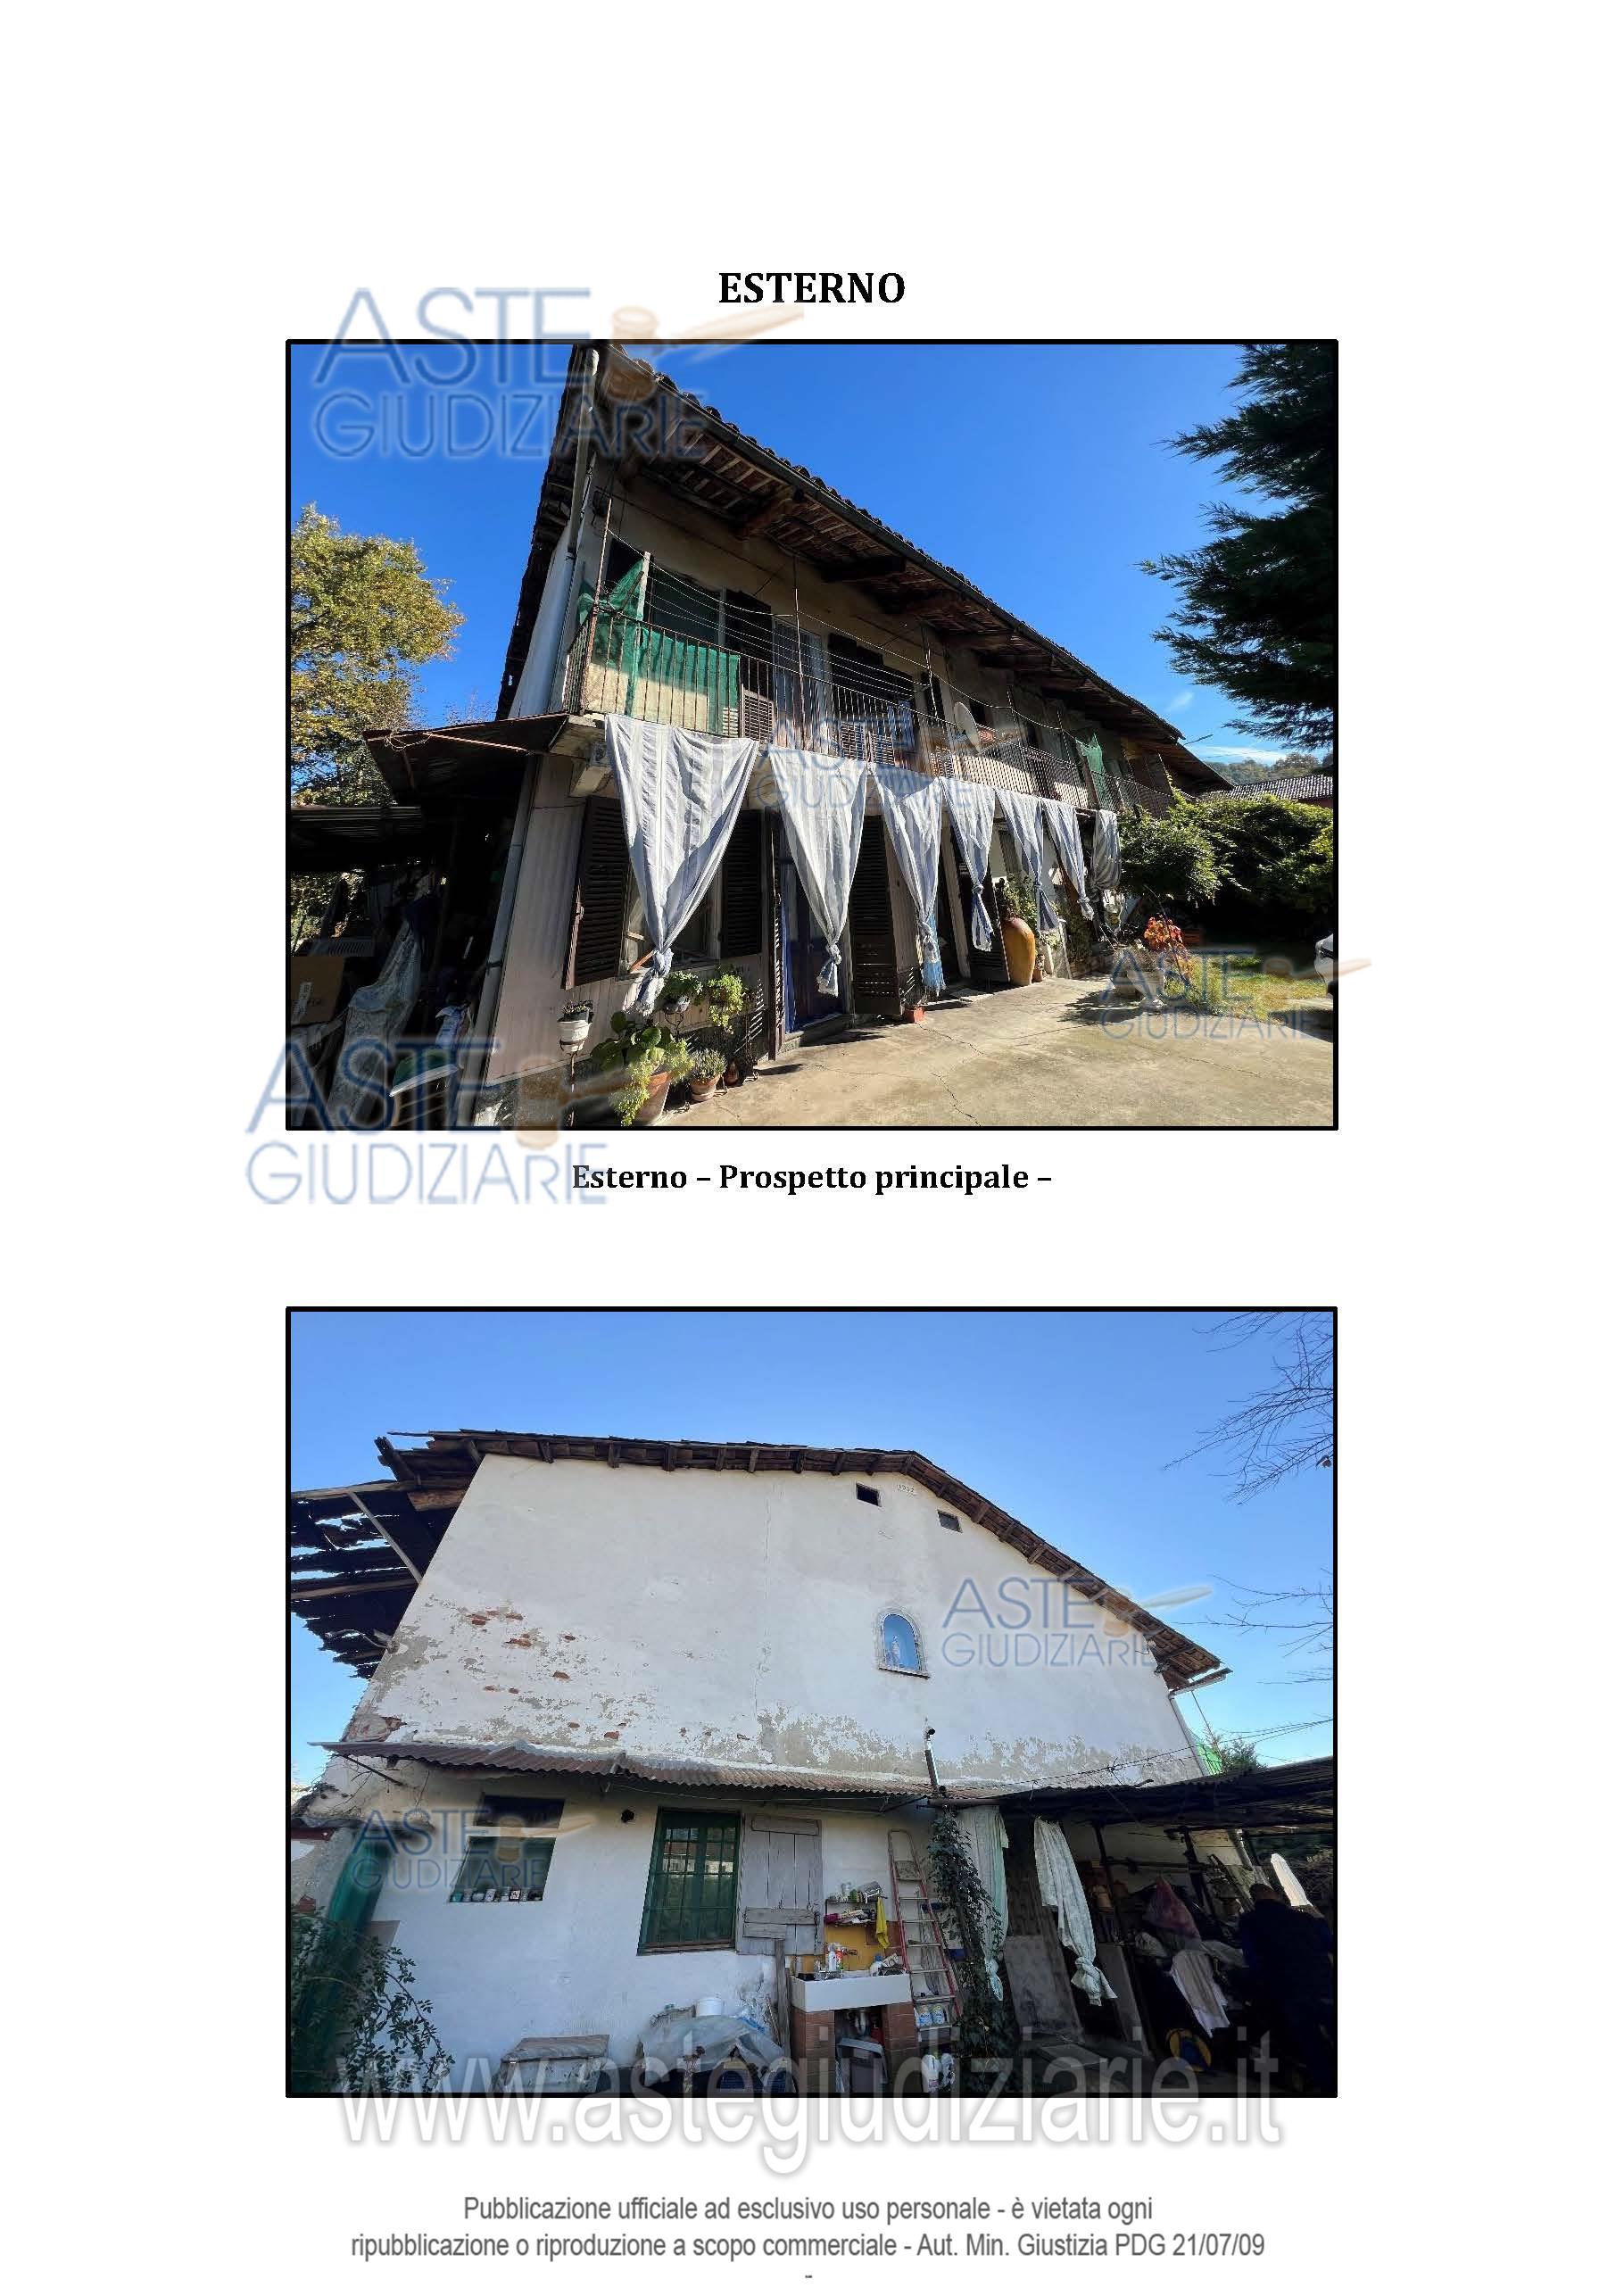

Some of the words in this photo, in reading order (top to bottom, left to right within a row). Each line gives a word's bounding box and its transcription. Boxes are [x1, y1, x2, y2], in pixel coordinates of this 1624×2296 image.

[718, 272, 906, 303] ESTERNO
[572, 1165, 687, 1189] Esterno
[719, 1165, 866, 1196] Prospetto
[874, 1164, 1029, 1196] principale
